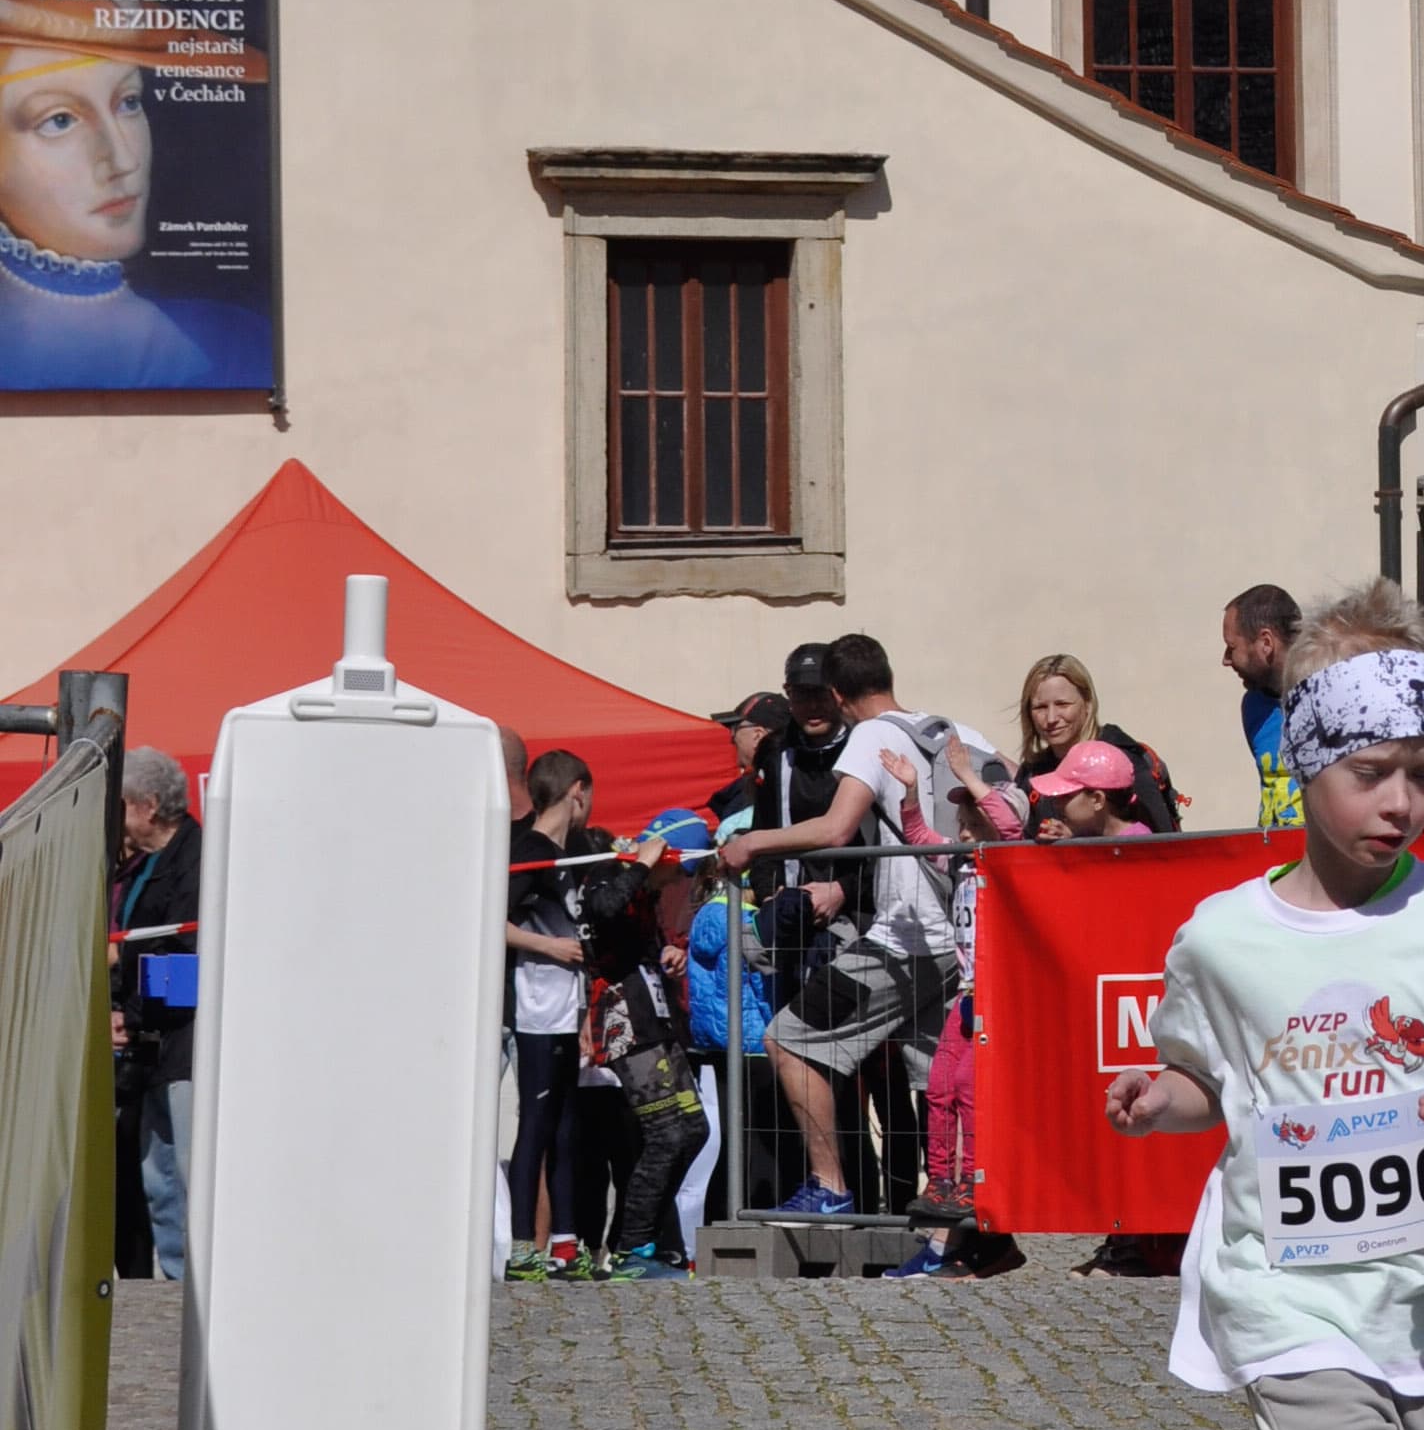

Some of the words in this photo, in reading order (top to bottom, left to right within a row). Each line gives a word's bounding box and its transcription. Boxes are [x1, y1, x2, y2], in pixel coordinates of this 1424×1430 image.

[94, 7, 245, 31] REZIDENCE
[168, 37, 245, 58] nejstarší
[156, 65, 245, 79] renesance
[154, 88, 166, 102] v
[171, 82, 245, 102] Čechách
[1287, 1012, 1348, 1034] PVZP
[1258, 1031, 1374, 1073] Fénix
[1323, 1069, 1385, 1098] run
[1351, 1109, 1398, 1130] PVZP
[1296, 1244, 1329, 1256] PVZP
[1370, 1237, 1408, 1249] Centrum
